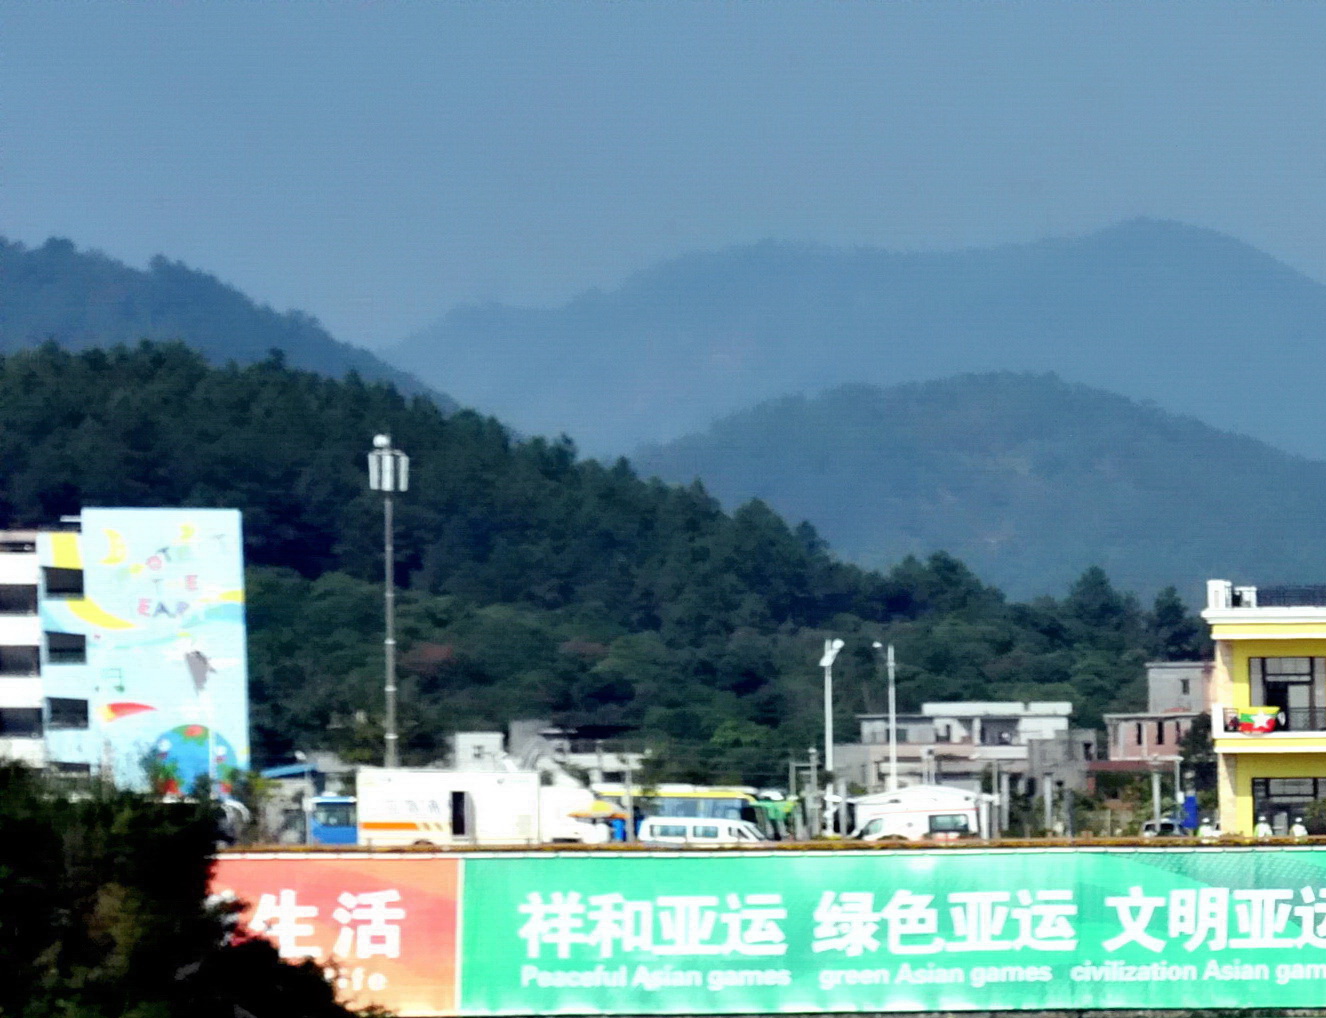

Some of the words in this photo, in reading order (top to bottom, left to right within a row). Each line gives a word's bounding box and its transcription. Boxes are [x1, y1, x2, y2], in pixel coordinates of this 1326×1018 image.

[518, 891, 788, 959] 祥和亚运
[812, 888, 1078, 957] 绿色亚运
[323, 967, 388, 990] ife
[520, 963, 628, 987] Peaceful
[631, 963, 703, 987] Asian
[707, 966, 791, 991] games
[819, 966, 890, 989] green
[894, 962, 967, 986] Asian
[970, 963, 1053, 987] games
[1070, 959, 1198, 982] civilization
[1203, 959, 1270, 982] Asian
